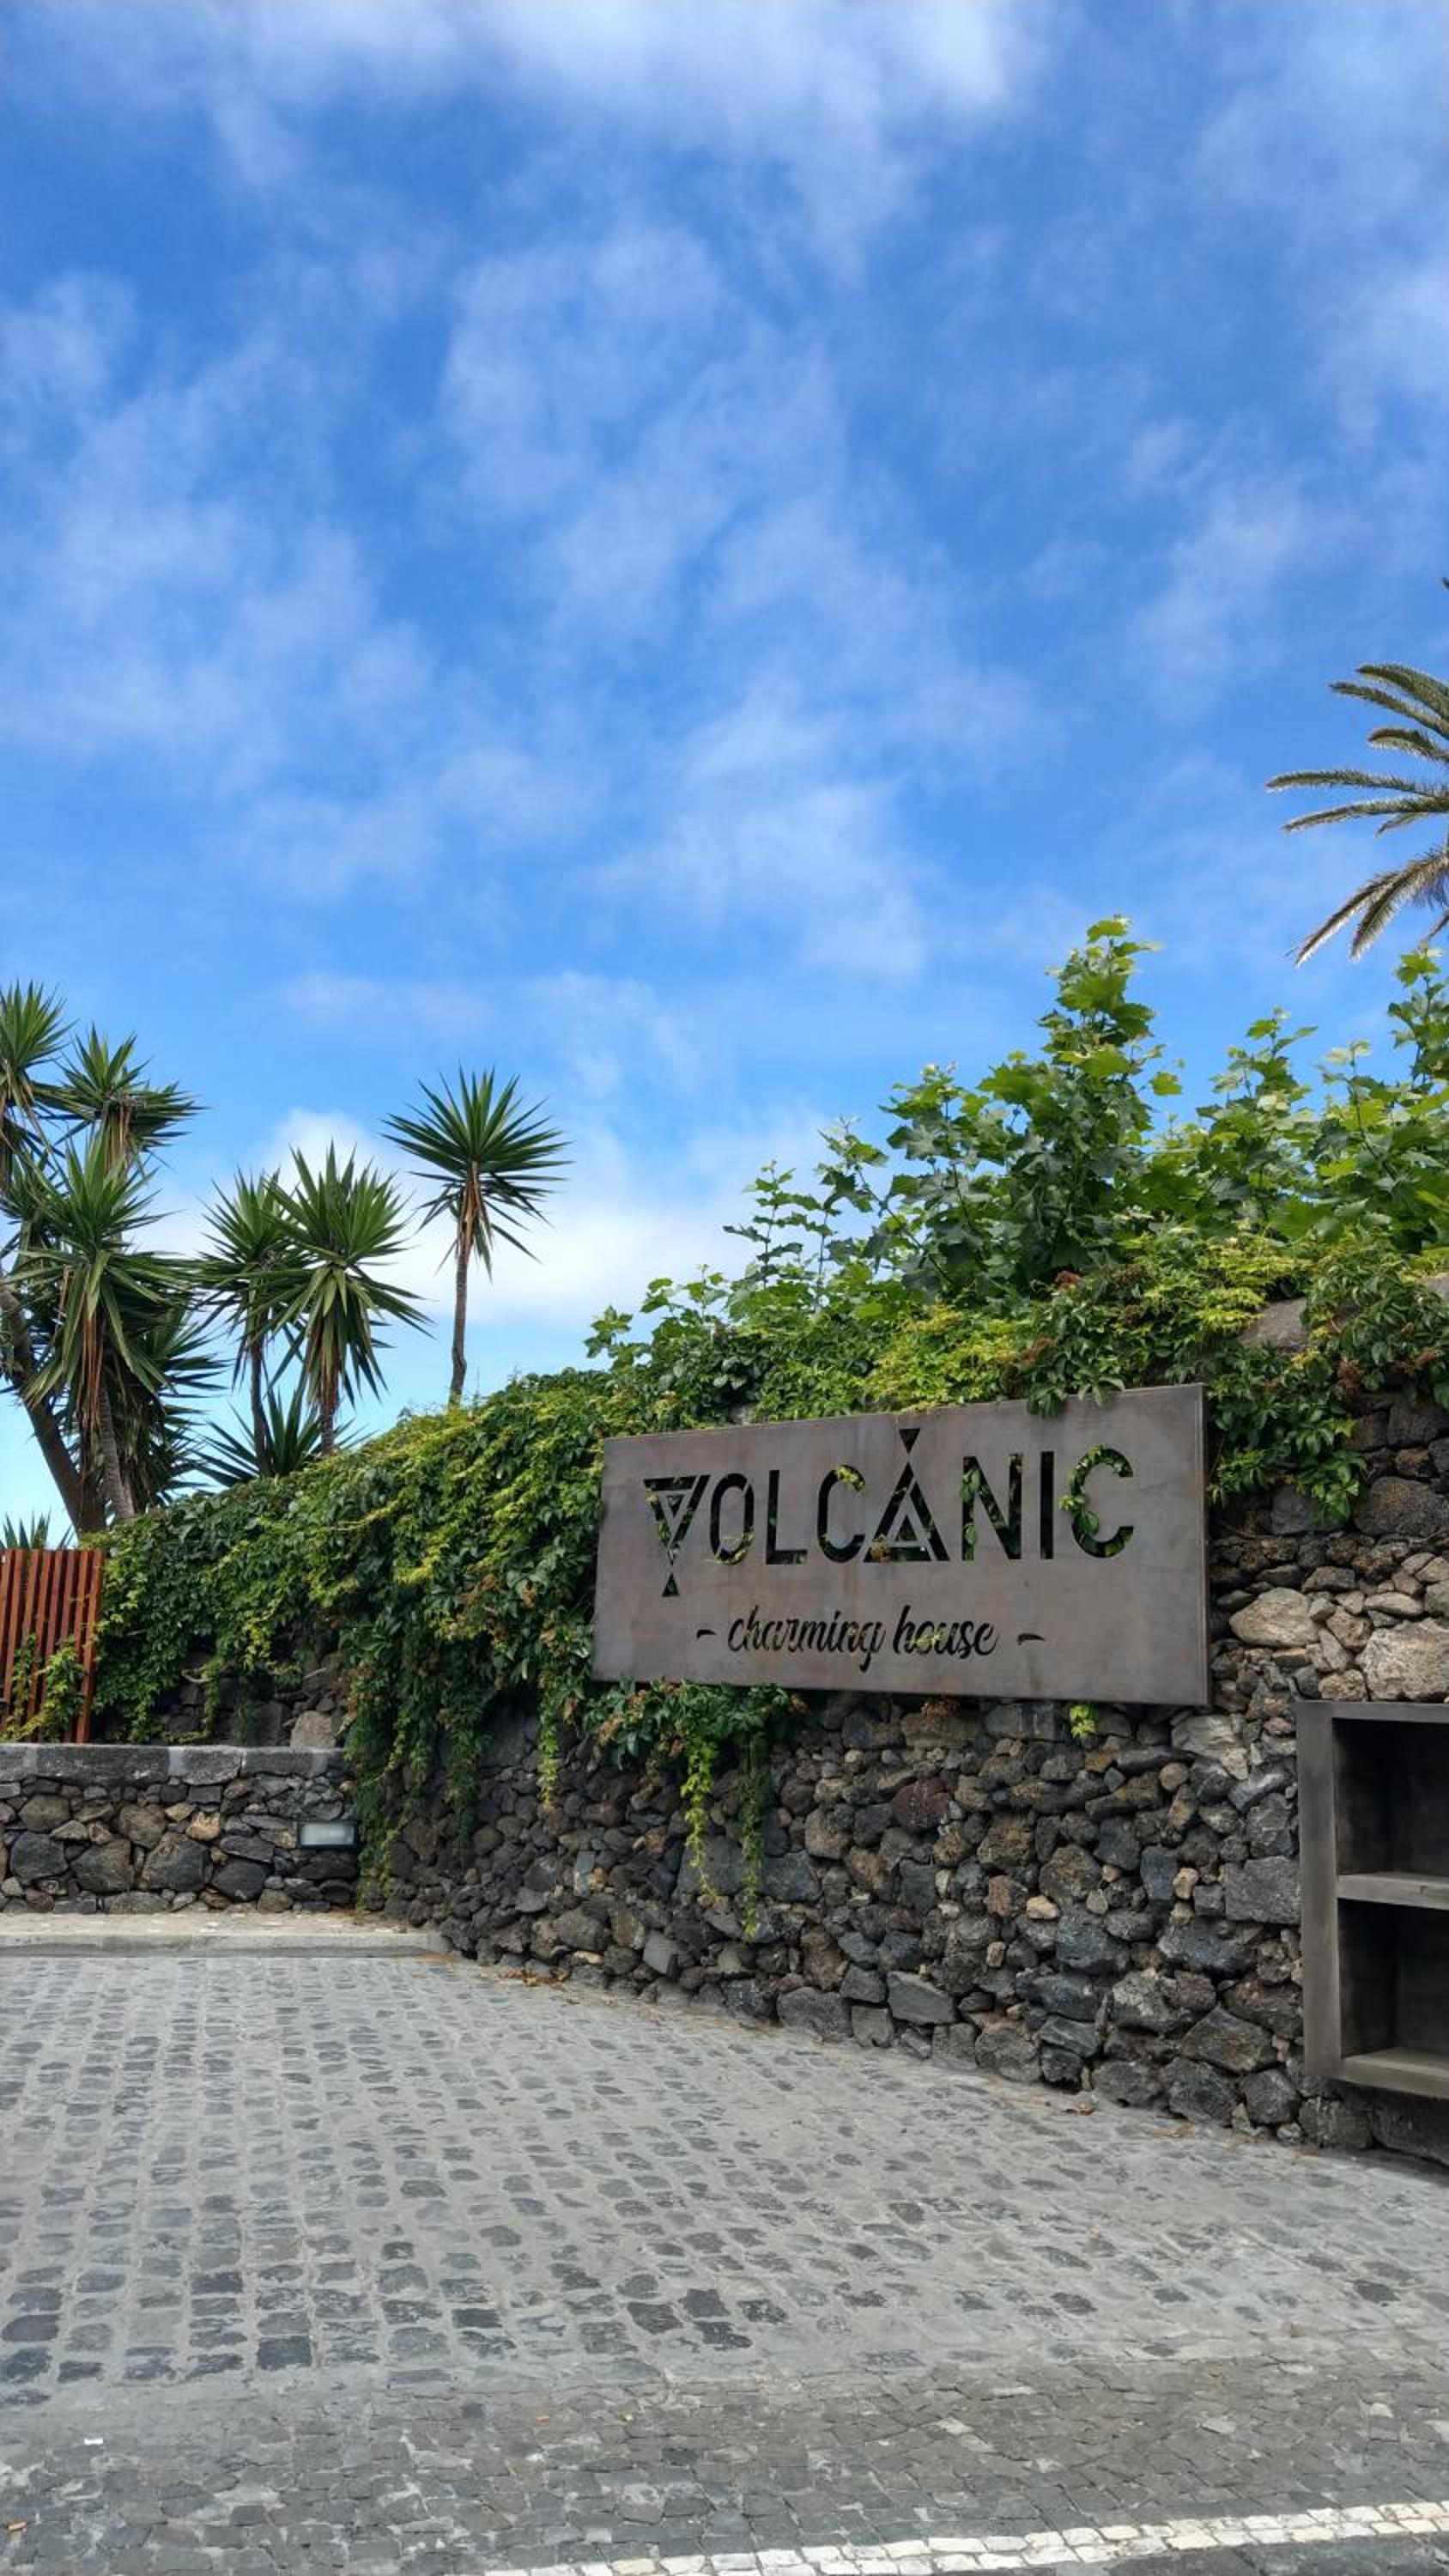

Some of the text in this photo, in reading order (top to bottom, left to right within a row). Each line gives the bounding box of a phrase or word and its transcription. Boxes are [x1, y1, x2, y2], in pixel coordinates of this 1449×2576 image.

[643, 1428, 1134, 1596] VOLCANIC
[727, 1605, 998, 1671] charming house
